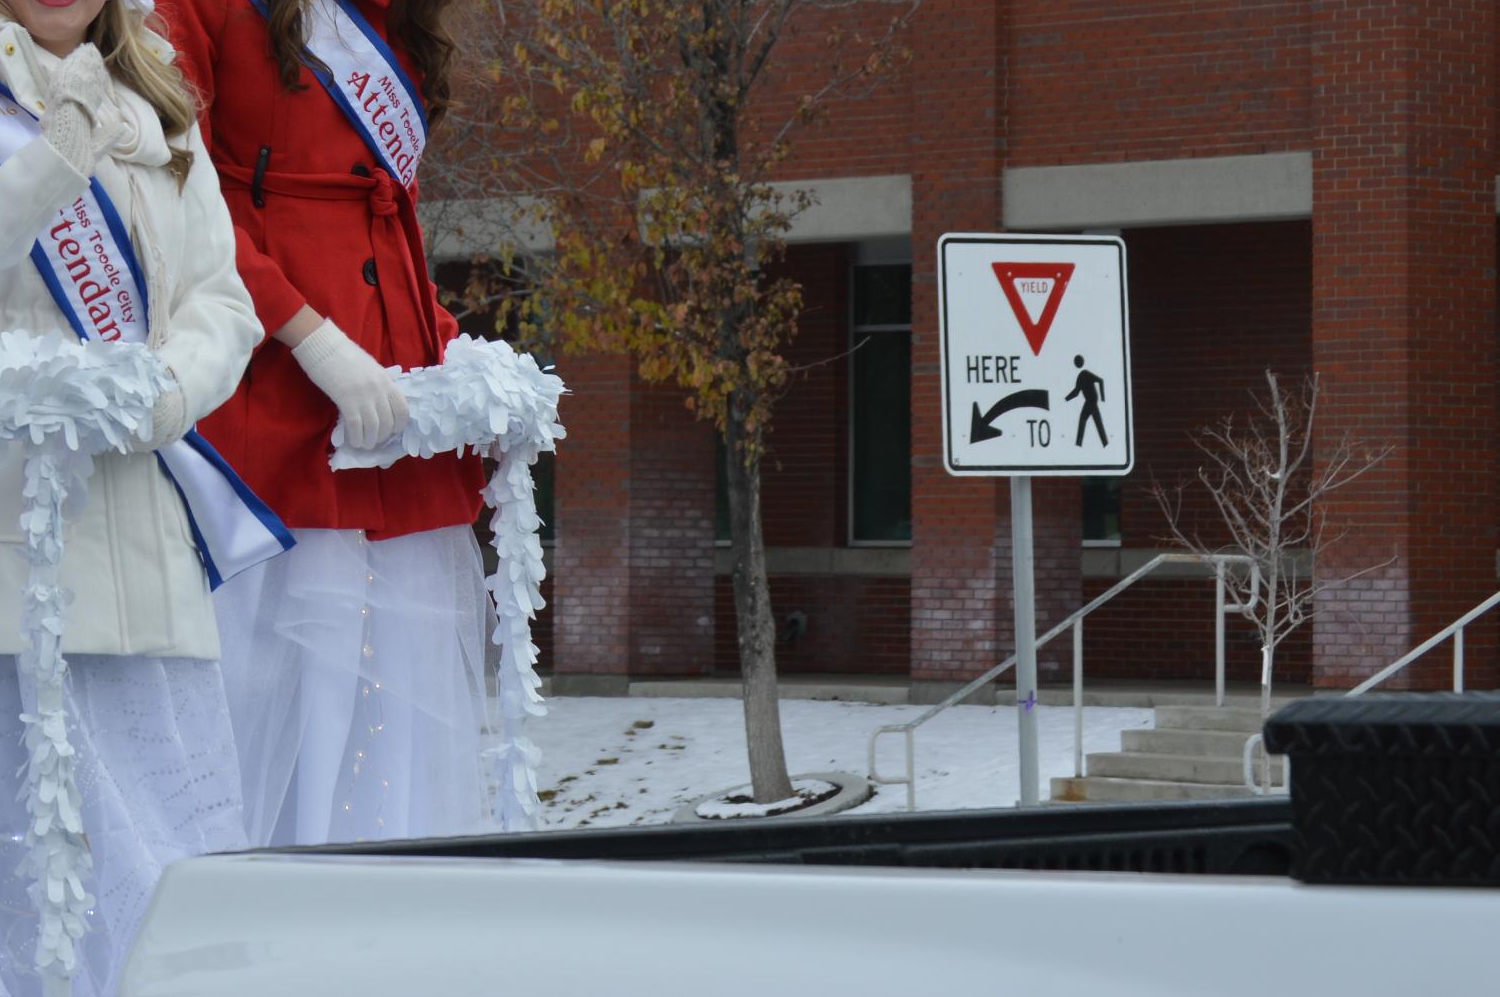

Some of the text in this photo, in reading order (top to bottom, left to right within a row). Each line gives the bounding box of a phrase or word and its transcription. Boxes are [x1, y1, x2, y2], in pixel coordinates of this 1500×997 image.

[347, 70, 415, 187] Attenda
[378, 75, 420, 153] Miss Tooele
[88, 230, 120, 288] Tooele
[117, 290, 136, 324] City
[1020, 281, 1048, 294] YIELD
[966, 355, 1022, 384] HERE
[1026, 419, 1051, 449] TO
